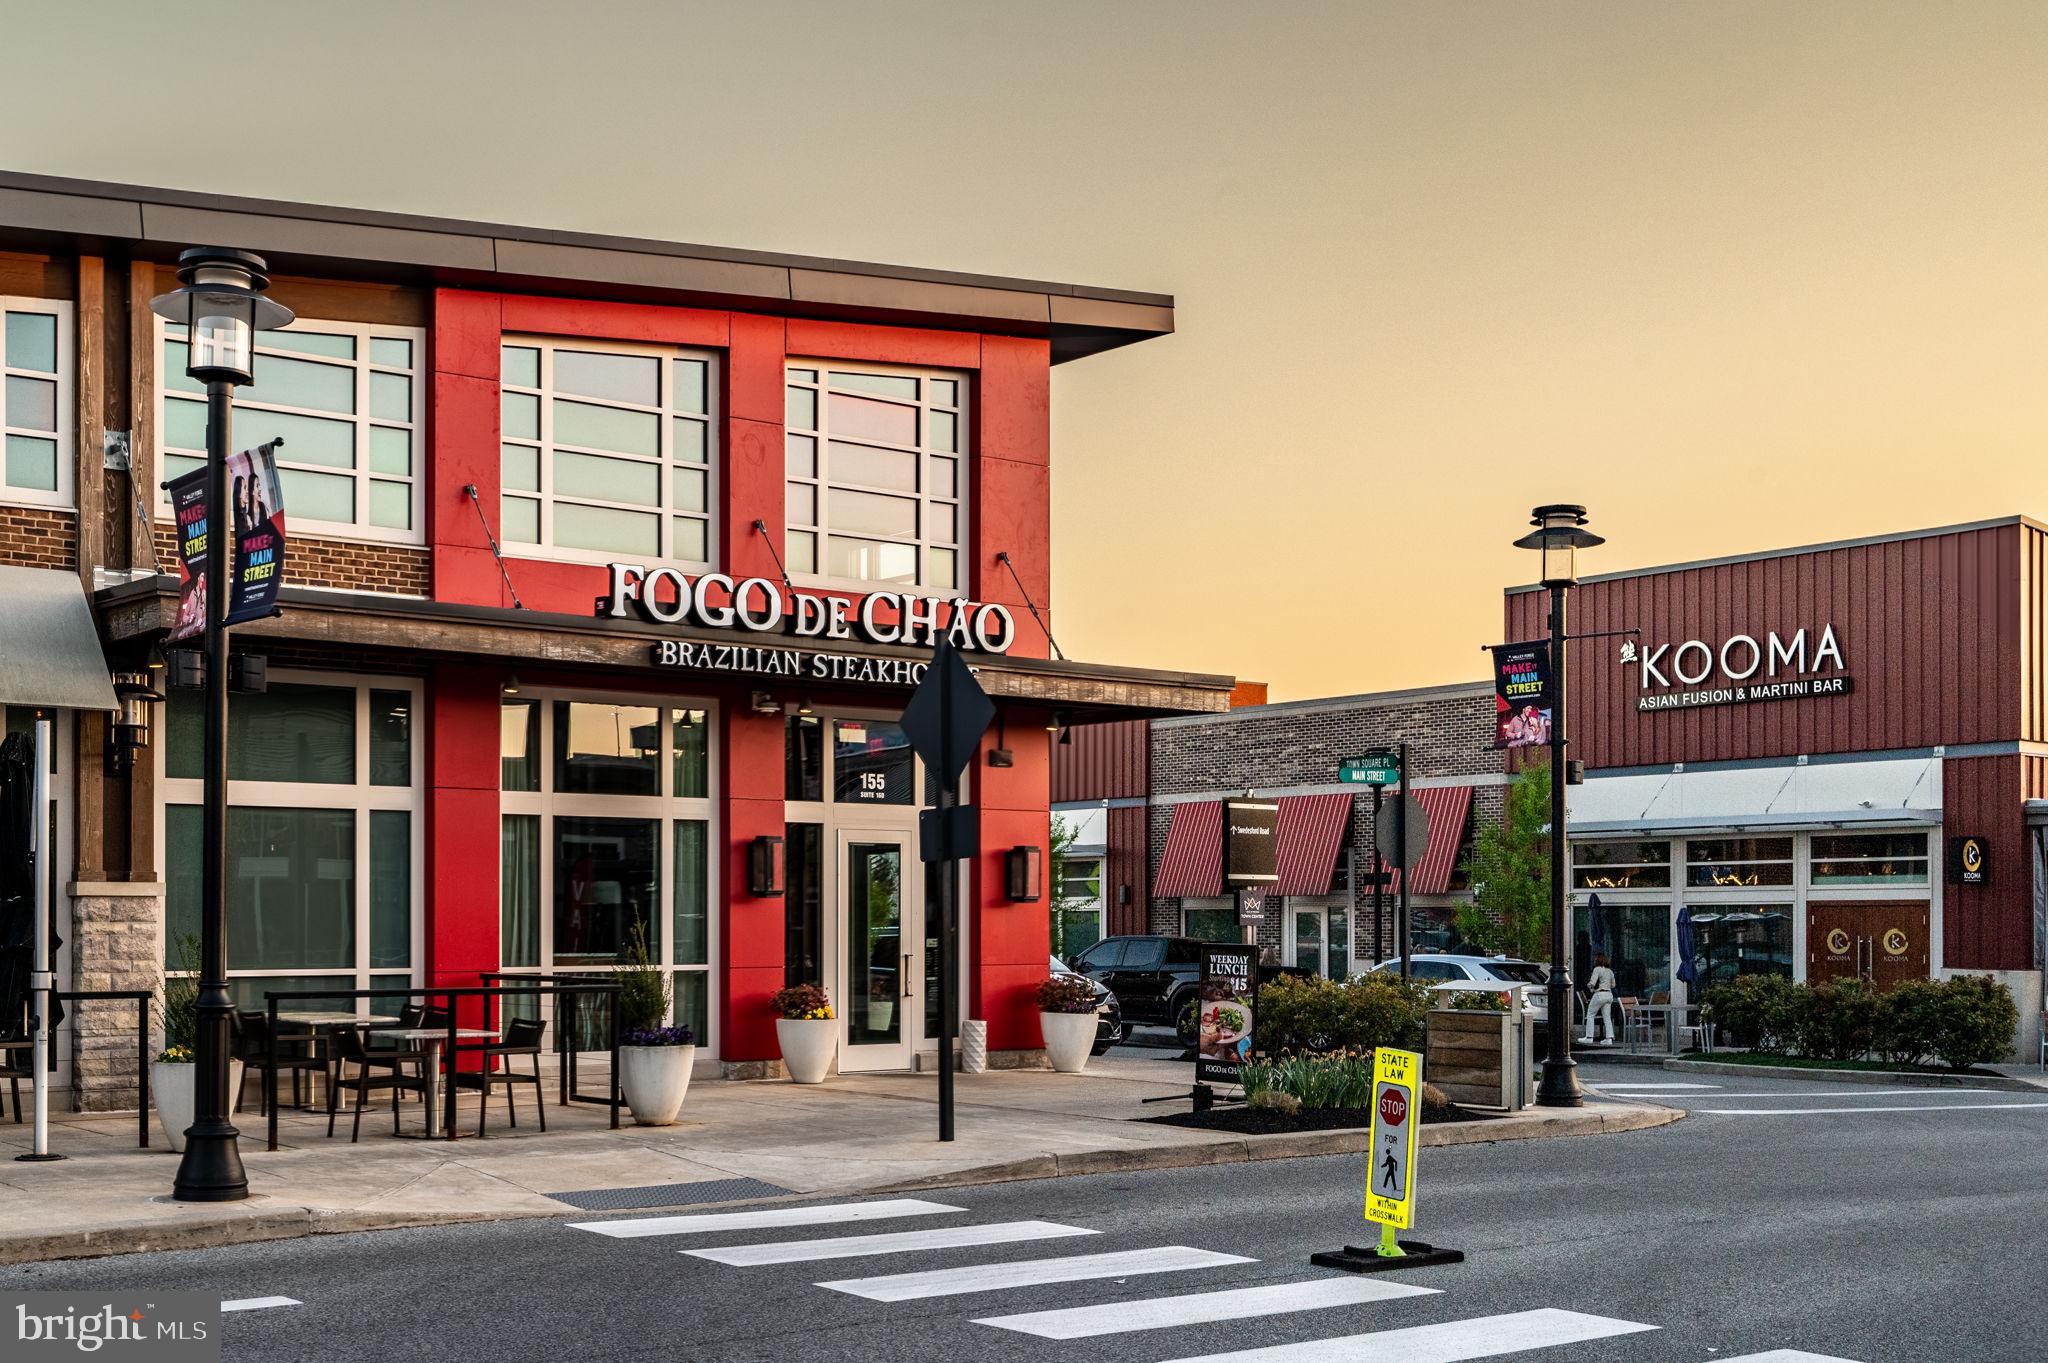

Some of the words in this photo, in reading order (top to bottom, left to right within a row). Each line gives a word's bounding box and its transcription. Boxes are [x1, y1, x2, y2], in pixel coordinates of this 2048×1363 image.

[179, 505, 203, 526] MAKE
[185, 535, 208, 557] STREE
[243, 535, 268, 553] MAKE
[250, 548, 273, 566] MAIN
[243, 562, 276, 583] STREET
[610, 562, 782, 631] FOGO
[794, 593, 851, 639] DE
[863, 591, 1015, 653] CHÃO
[660, 640, 800, 676] BRAZILIAN
[812, 653, 979, 686] STEAKHO
[1642, 622, 1844, 689] KOOMA
[1502, 663, 1531, 674] MAKE
[1511, 672, 1537, 684] MAIN
[1506, 681, 1543, 694] STREET
[1639, 694, 1679, 709] ASIAN
[1682, 689, 1733, 705] FUSION
[1737, 689, 1746, 700] &
[1750, 681, 1808, 699] MARTINI
[1813, 679, 1843, 693] BAR
[1362, 758, 1381, 768] SQUARE
[1383, 758, 1390, 767] PL
[860, 772, 885, 790] 155
[1352, 770, 1365, 780] MAIN
[1367, 771, 1386, 781] STREET
[1963, 872, 1981, 880] KOOMA
[1210, 954, 1249, 965] WEEKDAY
[1210, 964, 1248, 975] LUNCH
[1230, 977, 1248, 991] $15
[1205, 1064, 1221, 1073] FOGO
[1381, 1053, 1409, 1069] STATE
[1384, 1067, 1405, 1081] LAW
[1381, 1098, 1406, 1117] STOP
[1384, 1134, 1398, 1145] FOR
[1377, 1199, 1397, 1211] WITHIN
[1368, 1207, 1404, 1224] CROSSWALK
